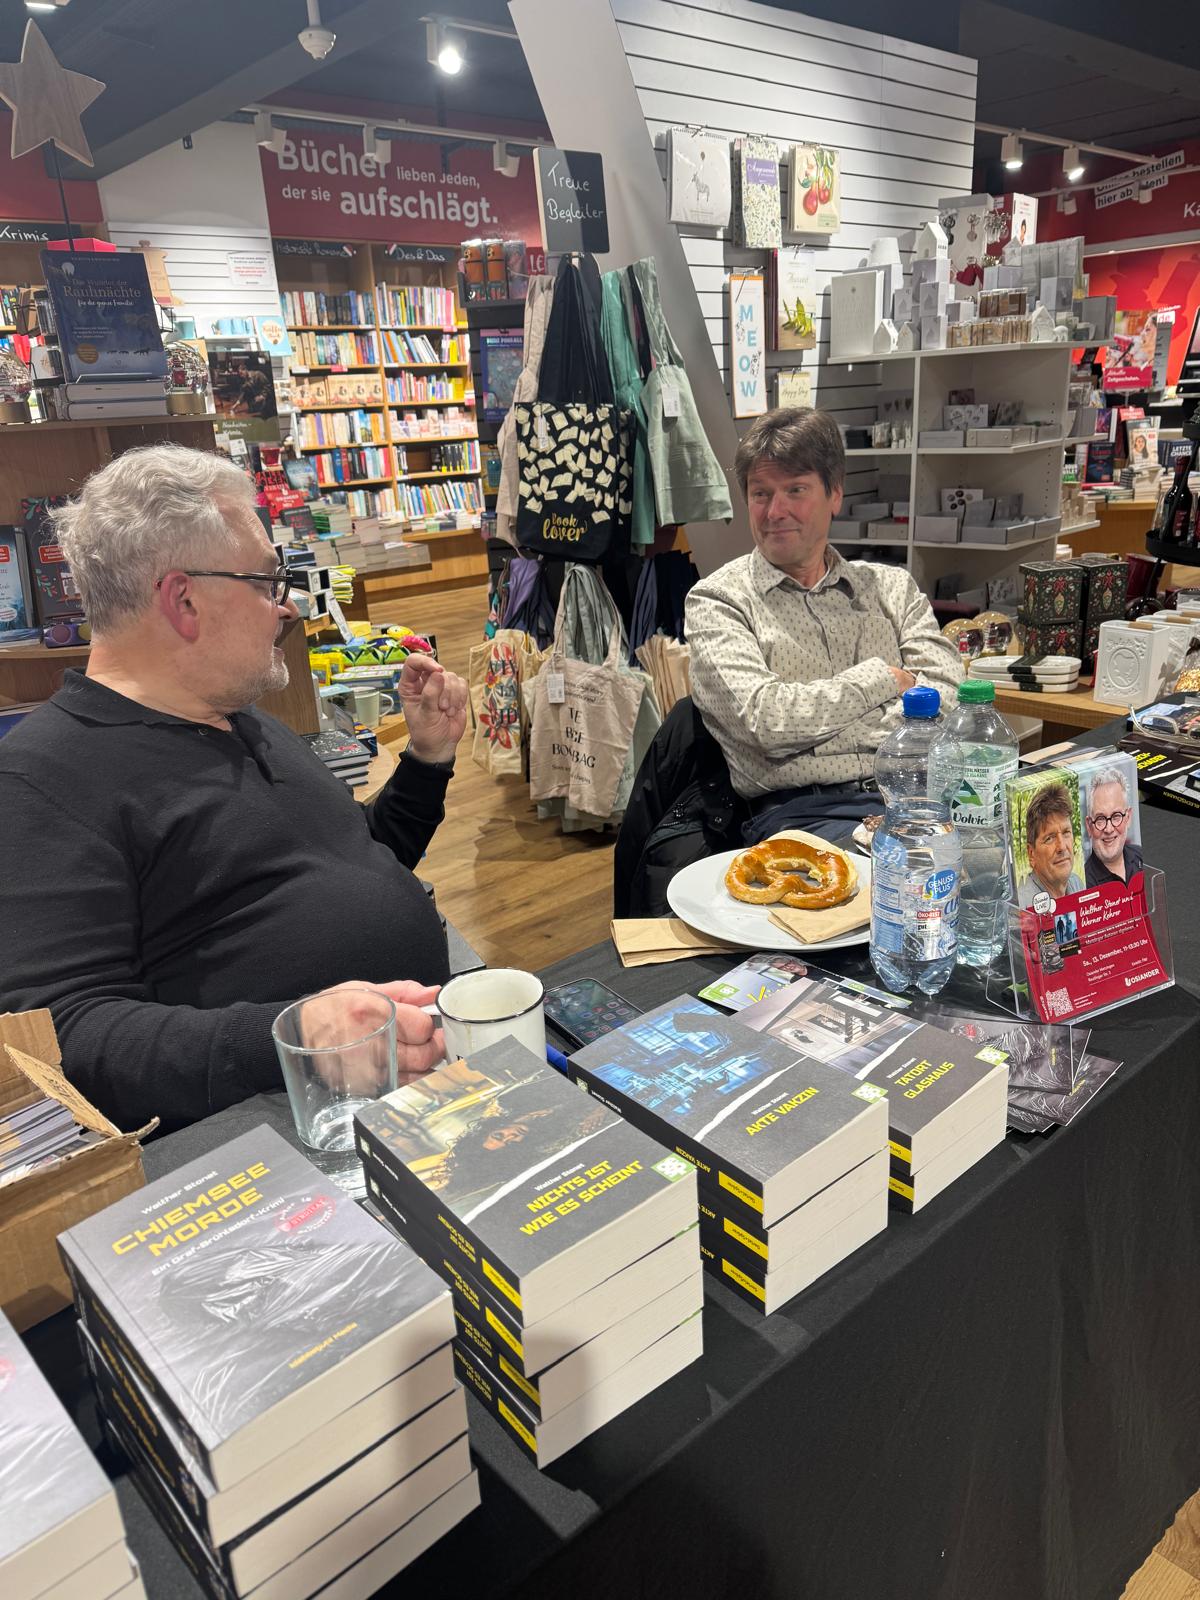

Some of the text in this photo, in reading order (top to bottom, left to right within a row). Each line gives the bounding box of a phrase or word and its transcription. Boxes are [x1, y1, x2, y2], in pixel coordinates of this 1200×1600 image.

[277, 138, 386, 179] Bücher
[396, 166, 436, 183] lieben
[547, 161, 590, 192] Treue
[281, 184, 498, 228] der sie aufschlägt.
[1097, 193, 1116, 208] hier
[0, 225, 49, 243] Krimis
[426, 249, 446, 262] Das
[63, 285, 141, 299] Rauhnächte
[953, 812, 988, 825] Volvic
[928, 874, 954, 888] GENUSS
[934, 884, 951, 894] PLUS
[1080, 903, 1103, 917] Walther
[1105, 897, 1121, 909] Stonet
[1081, 915, 1103, 928] Werner
[1103, 908, 1121, 922] Kehrer
[1099, 948, 1124, 961] Dezember,
[1139, 938, 1149, 947] Uhr
[1130, 968, 1161, 984] OSIANDER
[894, 1059, 932, 1086] TATORT
[903, 1061, 955, 1099] GLASHAUS
[745, 1086, 820, 1136] AKTE VAKZIN
[141, 1170, 219, 1216] Walther Stonet
[519, 1160, 644, 1236] WIE ES SCHEINT
[526, 1160, 613, 1213] NICHTS IST
[111, 1161, 271, 1256] CHIEMSEE
[148, 1186, 264, 1257] MORDE
[151, 1261, 171, 1277] Ein
